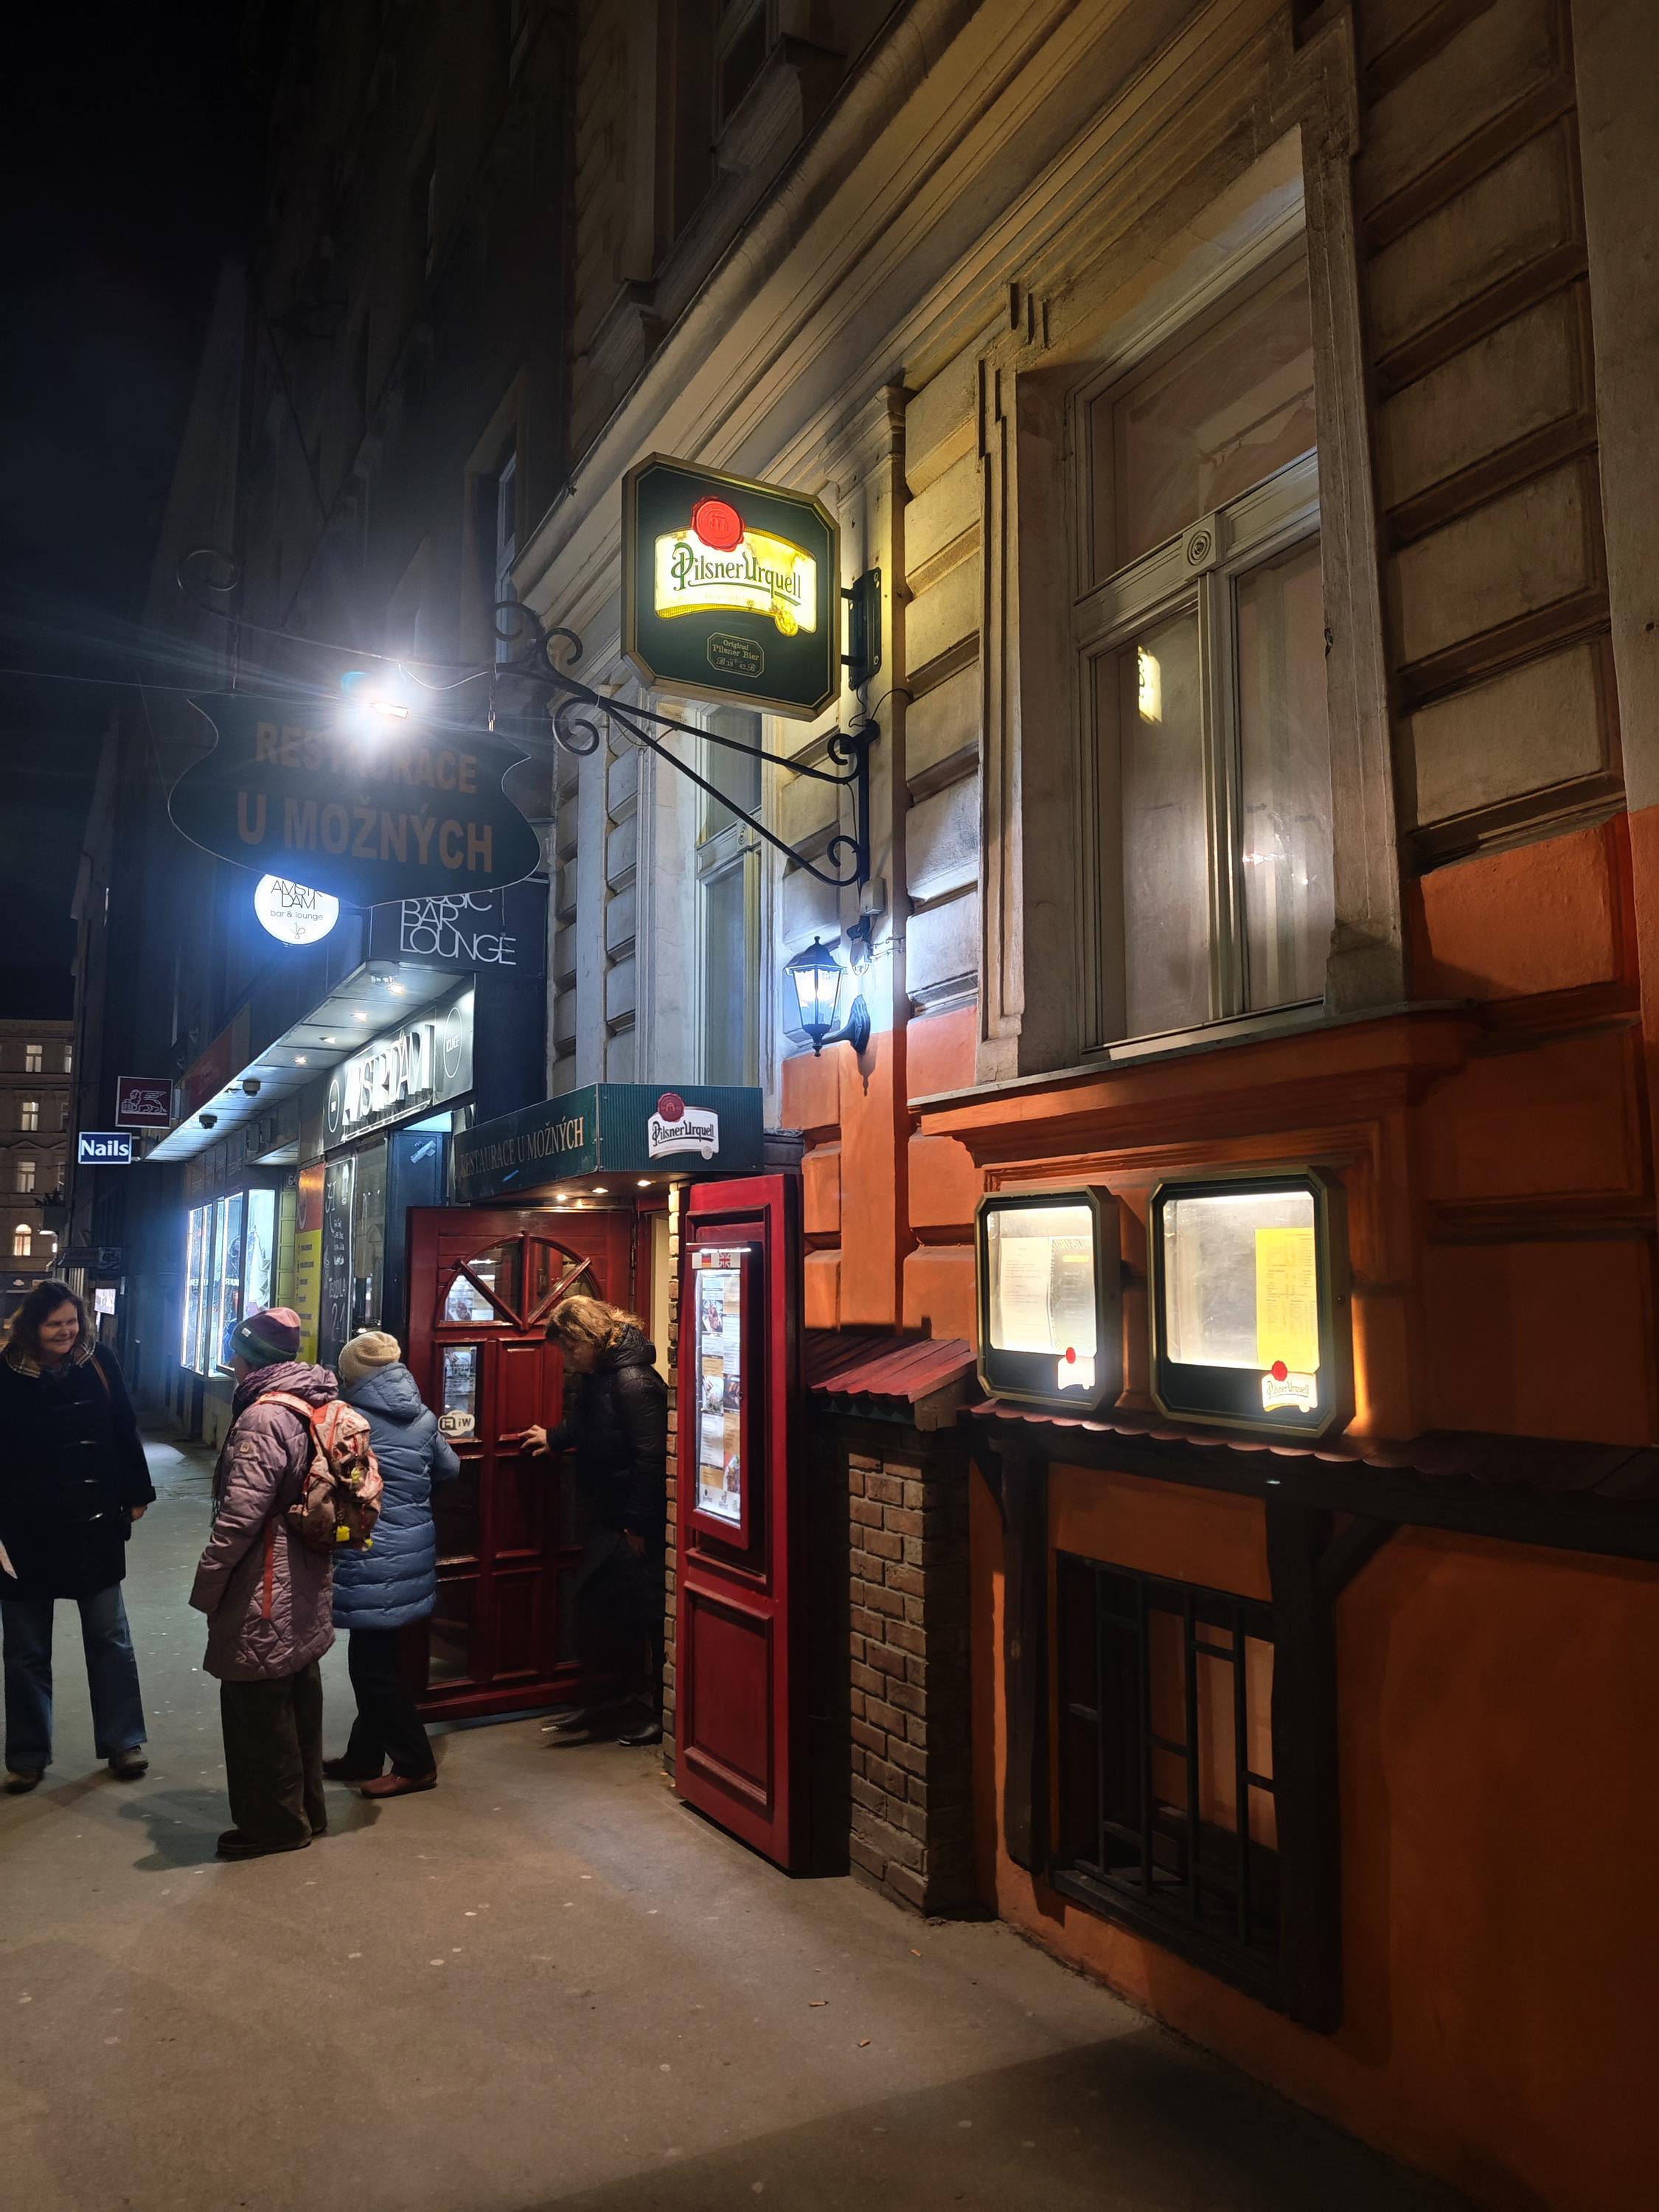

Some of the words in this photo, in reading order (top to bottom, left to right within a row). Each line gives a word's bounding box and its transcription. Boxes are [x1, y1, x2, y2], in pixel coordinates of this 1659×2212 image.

[670, 541, 744, 591] Pilsner
[742, 551, 801, 599] Urquell
[712, 644, 740, 656] Pilsner
[743, 650, 759, 661] Bier
[723, 639, 749, 650] Original
[237, 790, 266, 846] U
[283, 794, 493, 873] MOŽNÝCH
[282, 894, 316, 910] DAM
[401, 900, 459, 931] BAR
[295, 911, 324, 921] lounge
[400, 926, 516, 965] LOUNGE
[460, 1138, 515, 1178] RESTAURACE
[517, 1136, 524, 1163] U
[526, 1116, 584, 1161] MOŽNÝCH
[652, 1121, 684, 1147] Pilsner
[684, 1120, 714, 1142] Urquell
[80, 1139, 129, 1157] Nails
